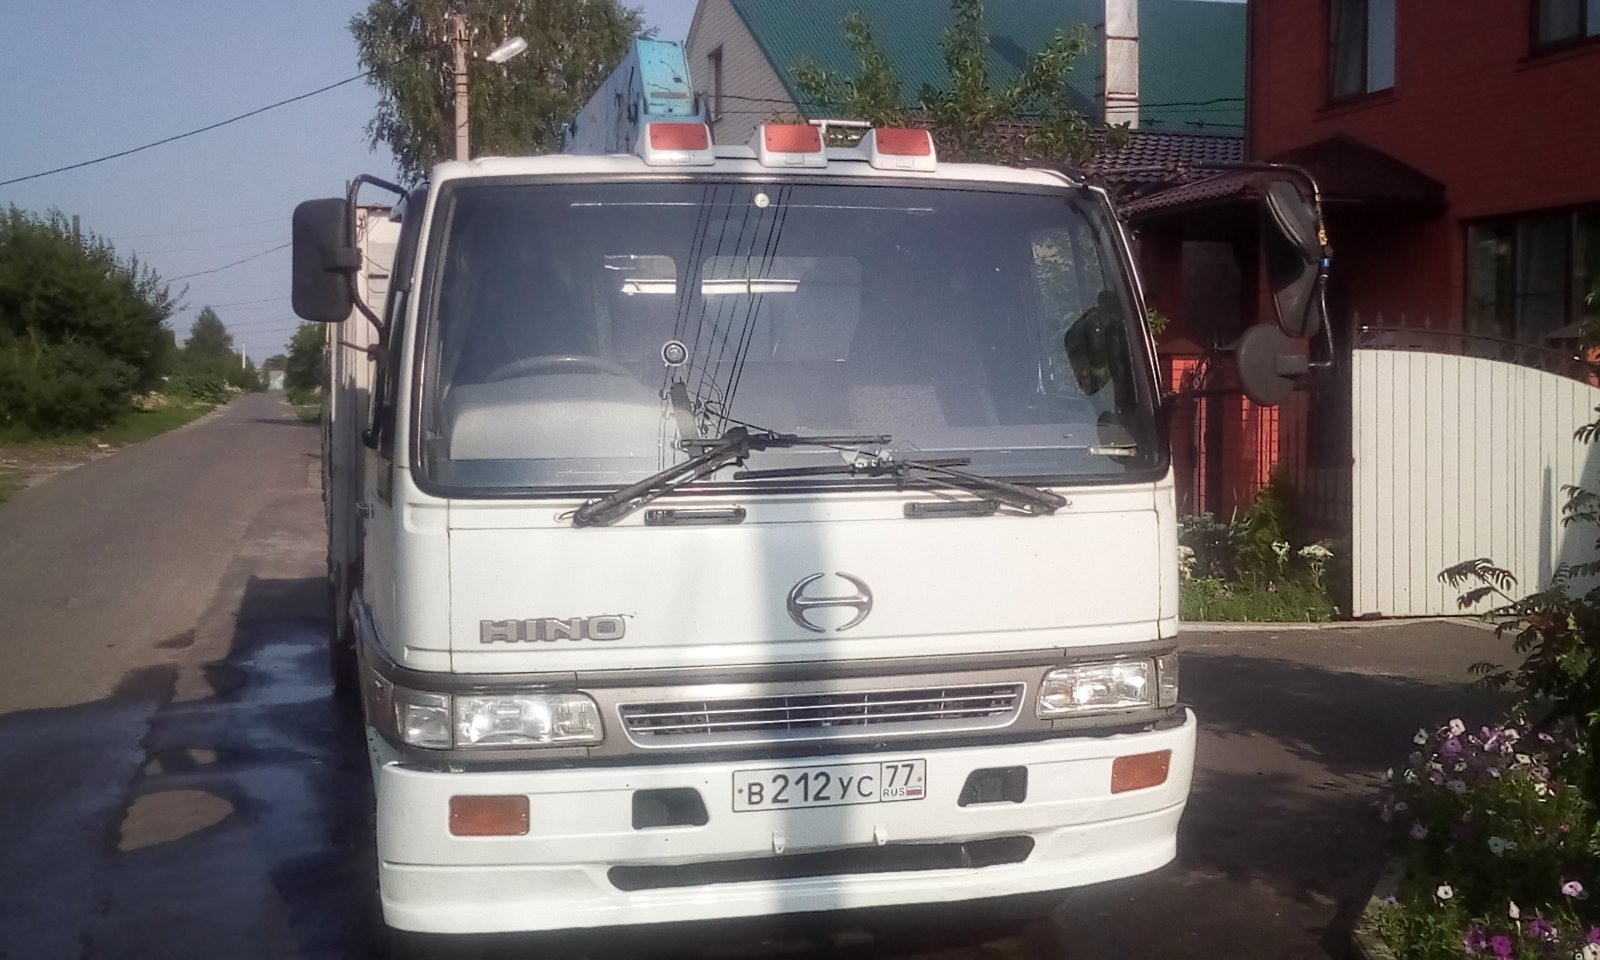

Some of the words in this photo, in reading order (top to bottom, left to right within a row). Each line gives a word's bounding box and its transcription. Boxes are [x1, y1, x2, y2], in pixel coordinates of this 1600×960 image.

[480, 615, 626, 643] HINO
[885, 763, 915, 788] 77
[882, 787, 906, 798] RUS
